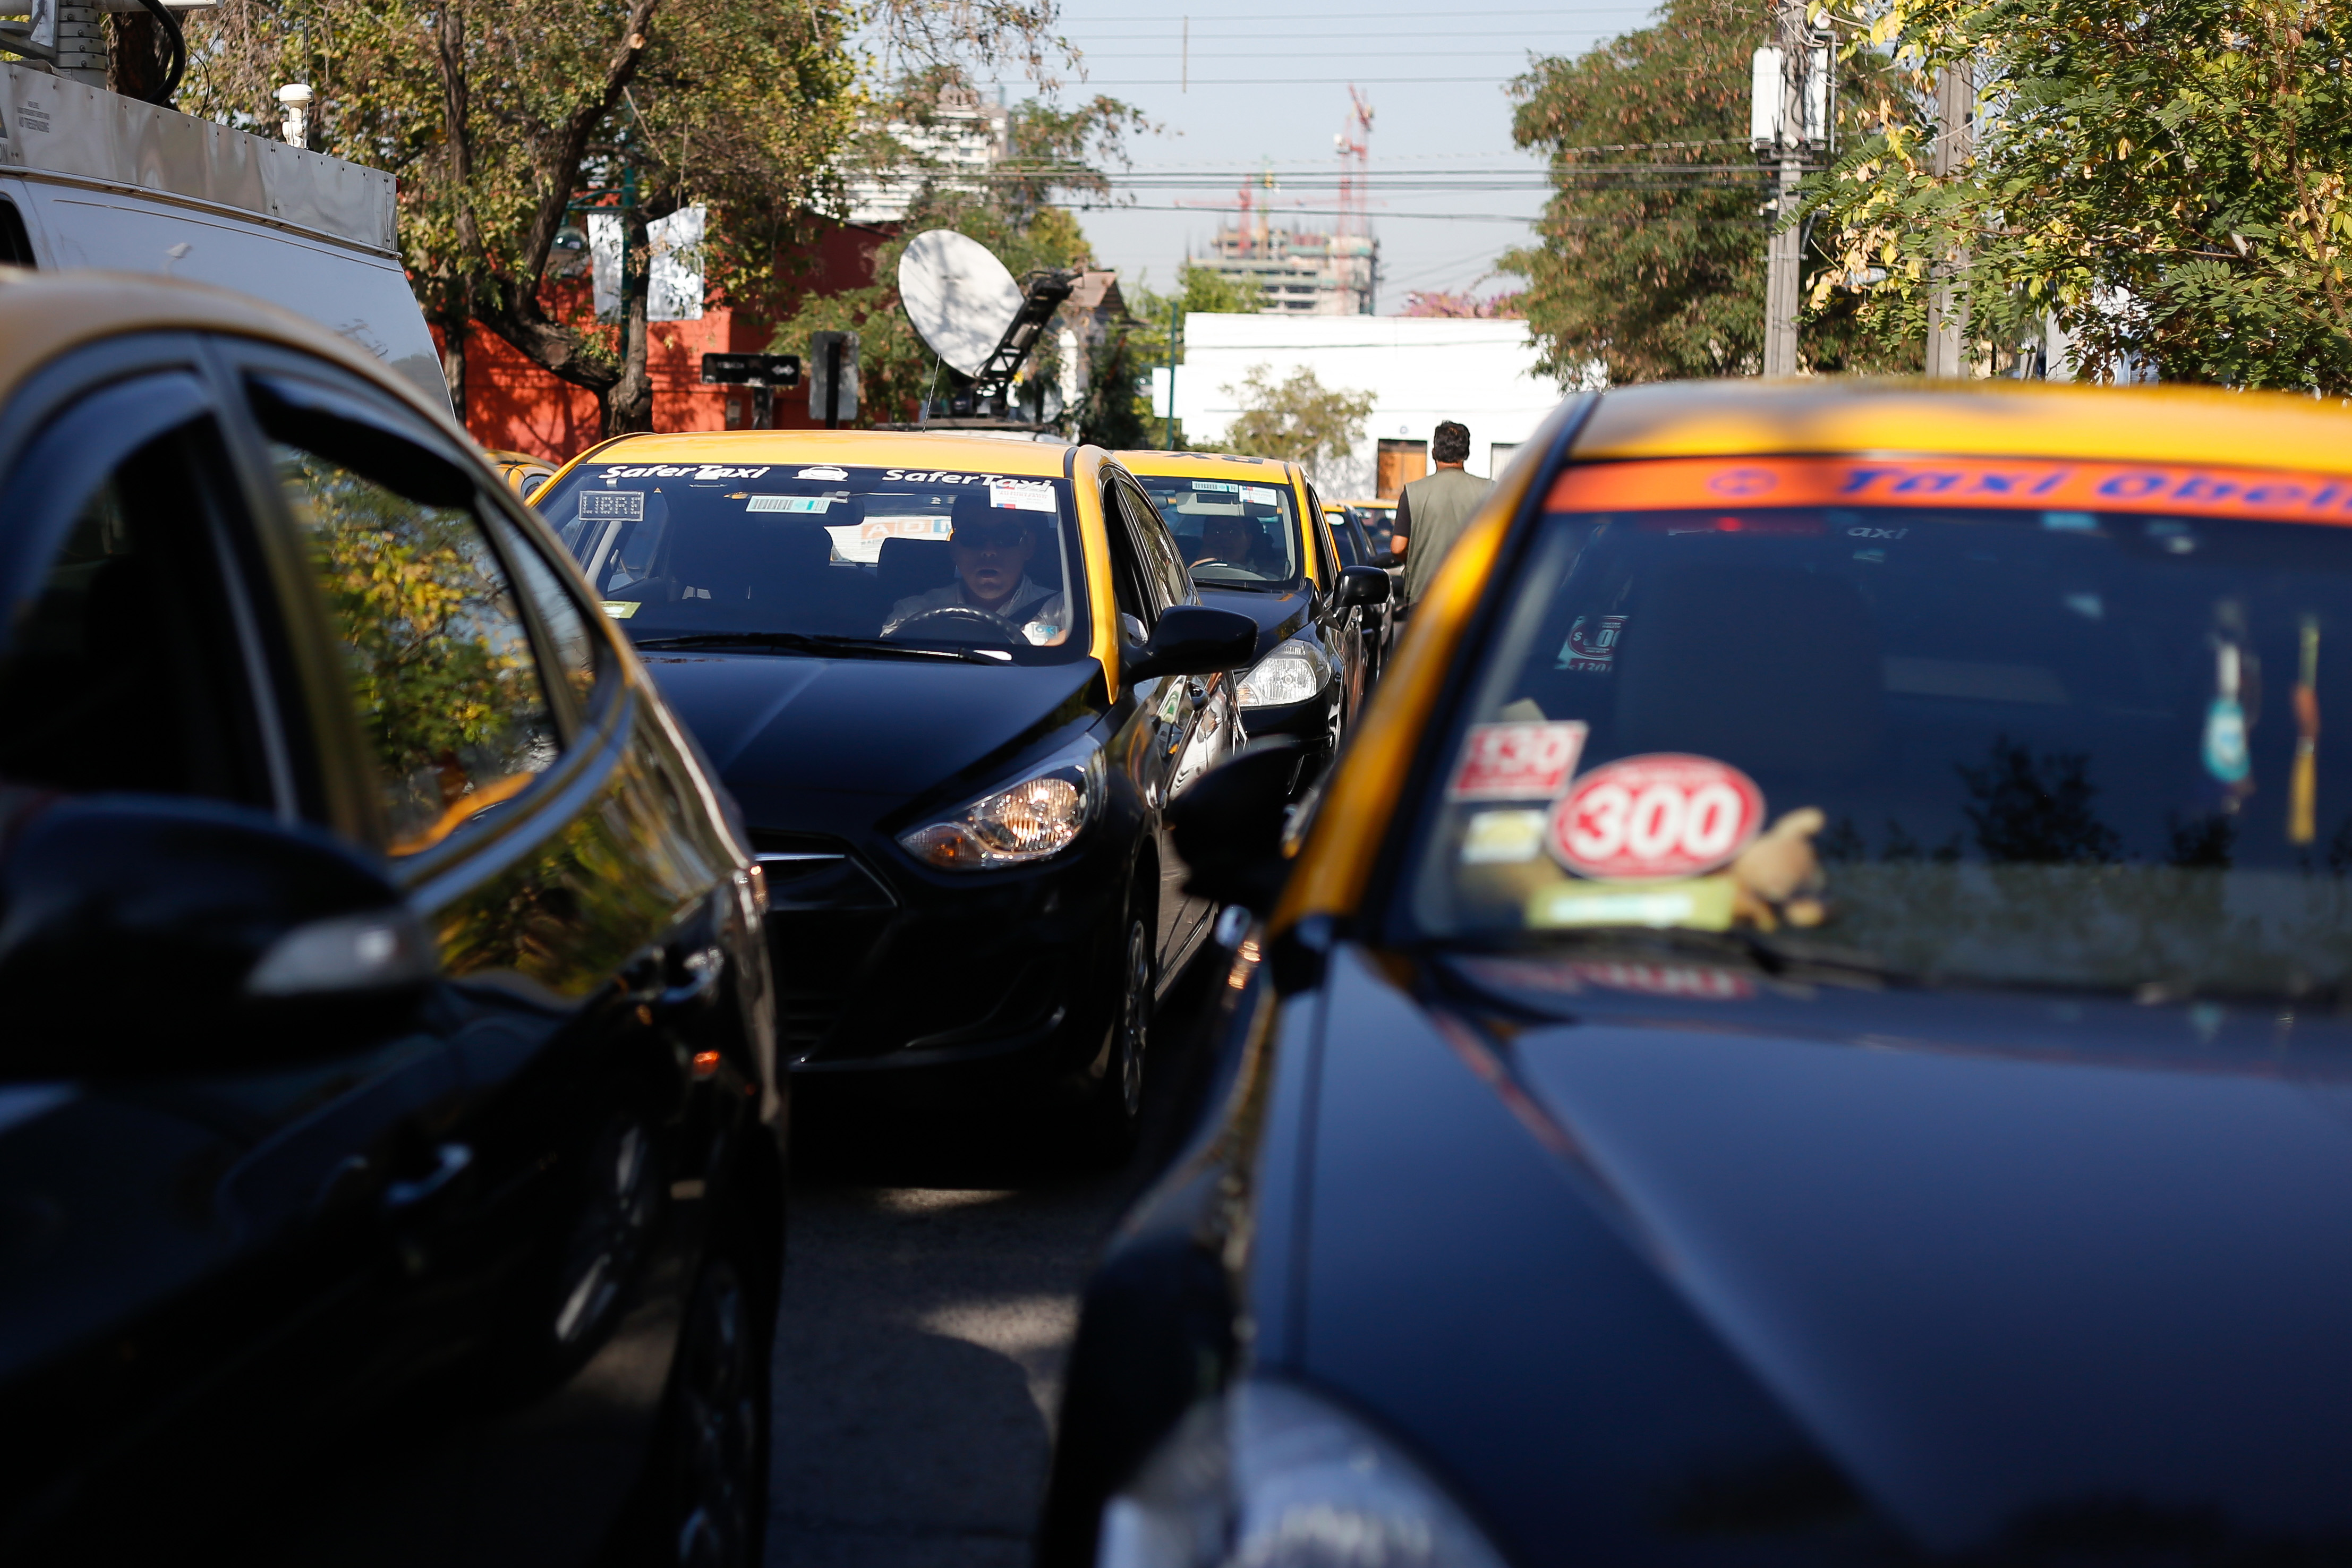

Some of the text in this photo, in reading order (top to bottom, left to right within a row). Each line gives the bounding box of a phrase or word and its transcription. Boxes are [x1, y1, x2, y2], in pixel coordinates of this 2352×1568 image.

[598, 465, 771, 480] SaferTaxi
[882, 469, 1052, 492] SaferTaxi
[583, 496, 641, 515] LIBRE
[1570, 782, 1743, 860] 300
